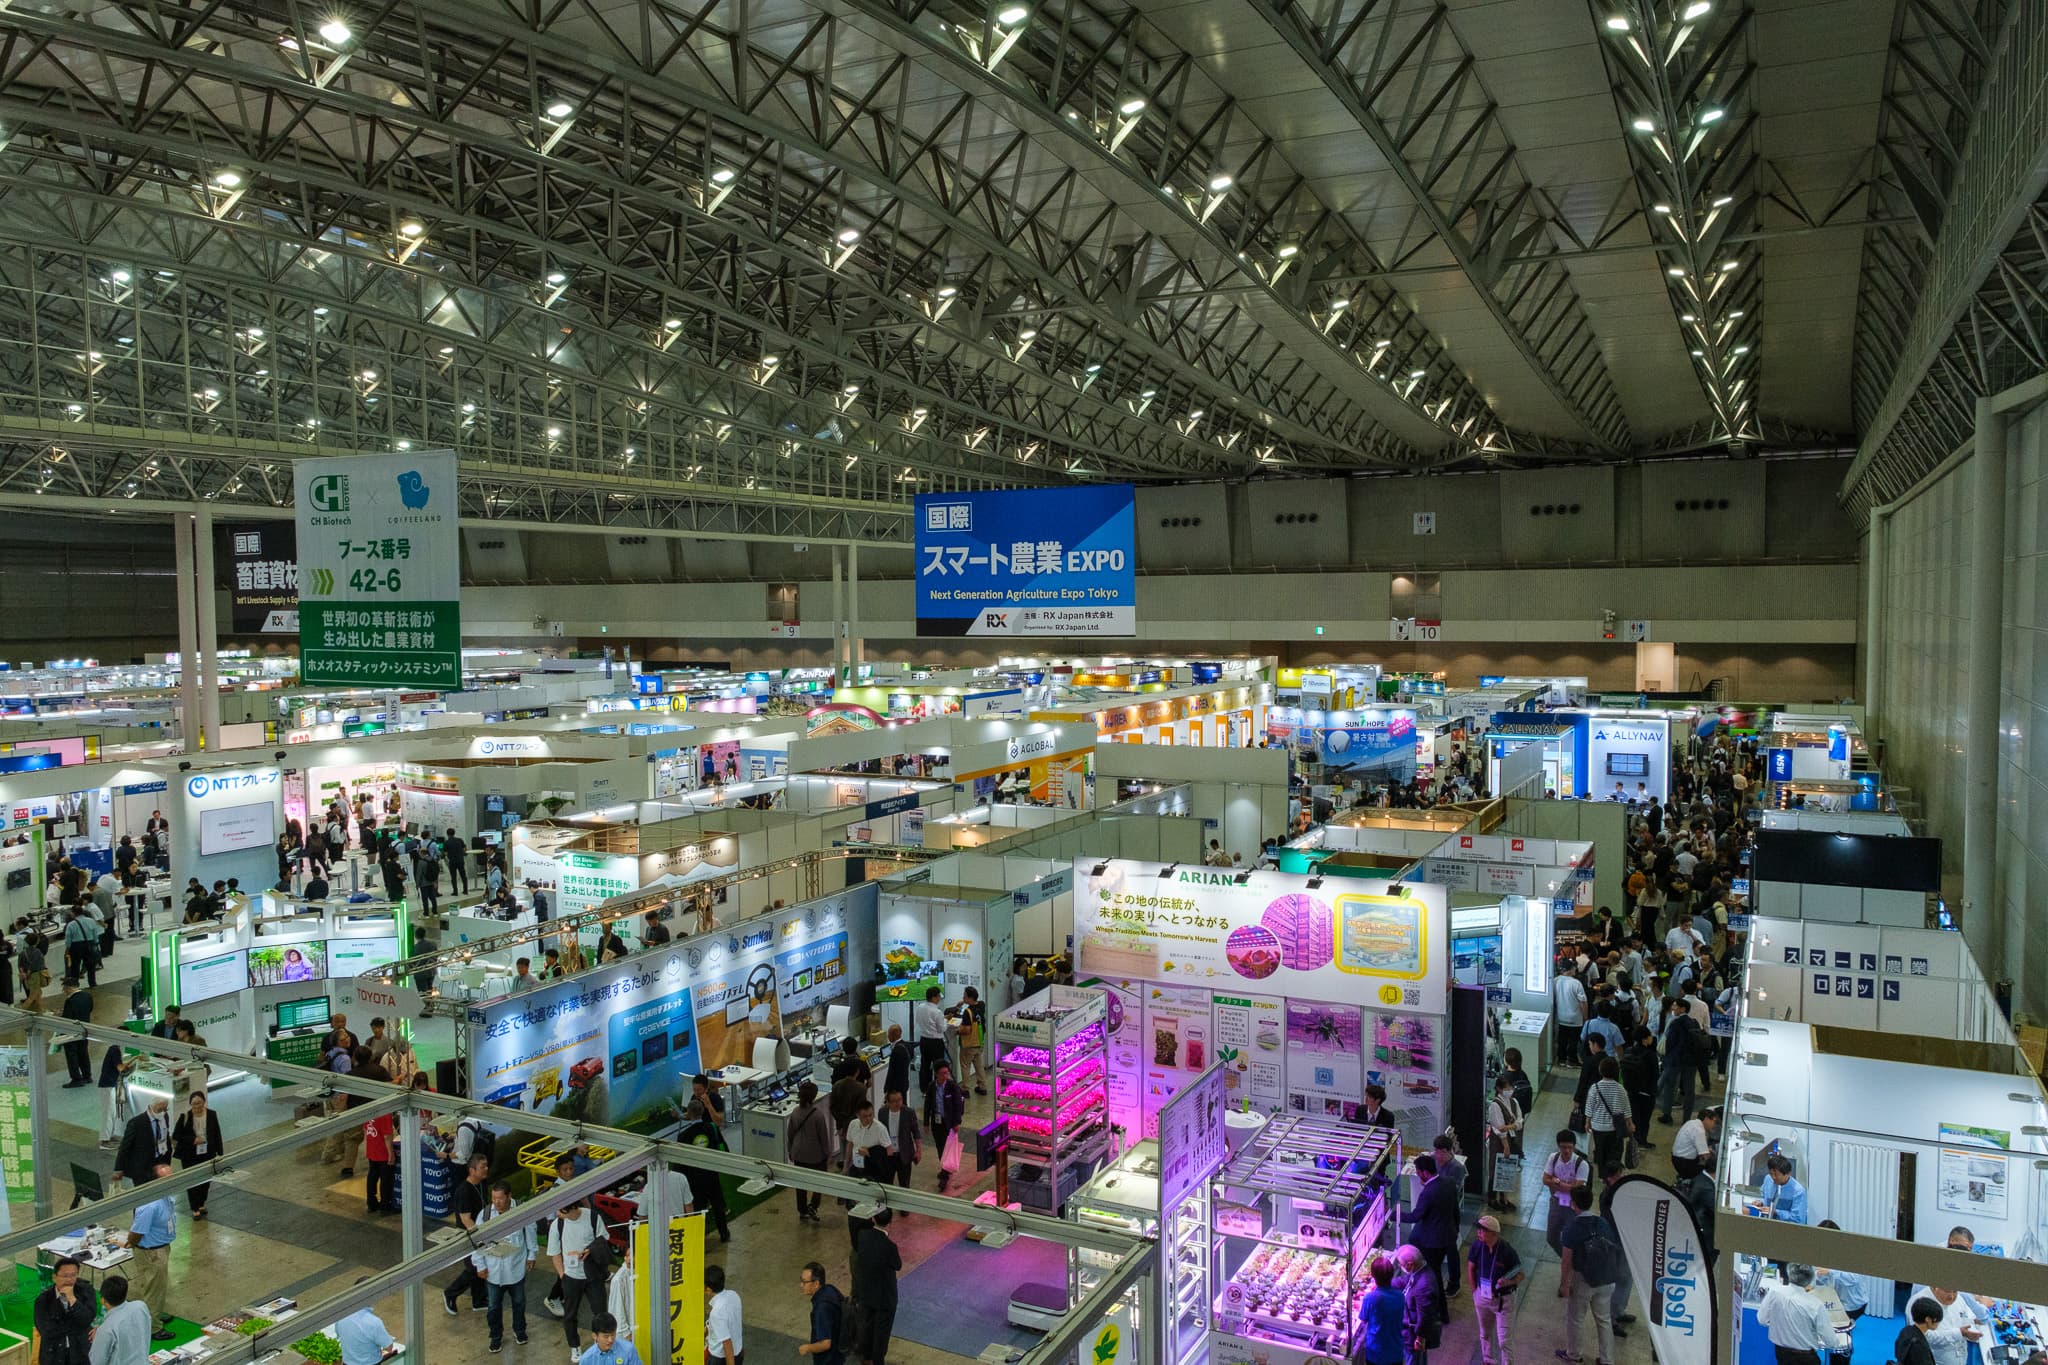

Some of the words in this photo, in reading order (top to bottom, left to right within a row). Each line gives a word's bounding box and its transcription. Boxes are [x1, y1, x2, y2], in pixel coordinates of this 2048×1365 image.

[311, 517, 321, 526] CH
[323, 516, 351, 526] Biotech
[388, 515, 442, 524] COFFEELAND
[928, 505, 970, 529] 国際
[235, 535, 260, 553] 国際
[338, 538, 411, 561] ブース番号
[349, 567, 401, 593] 42-6
[247, 596, 268, 604] Livestock
[270, 596, 286, 605] Supply
[931, 589, 951, 600] Next
[954, 588, 1003, 600] Generation
[1006, 588, 1058, 602] Agriculture
[1061, 588, 1085, 602] Expo
[1088, 587, 1118, 601] Tokyo
[272, 615, 284, 627] RX
[322, 610, 435, 628] 世界初の革新技術が
[986, 613, 1007, 628] RX
[1043, 611, 1056, 619] RX
[788, 626, 795, 637] 9
[1066, 624, 1086, 632] Japan
[1420, 627, 1436, 640] 10
[323, 630, 435, 649] 生み出した農業資材
[1508, 724, 1558, 734] ALLYNAV
[1613, 730, 1663, 742] ALLYNAV
[1021, 740, 1053, 754] AGLOBAL
[1776, 754, 1785, 775] NSW
[1113, 892, 1201, 912] この地の伝統が、
[1099, 906, 1229, 930] 未来の実りへとつながる
[742, 928, 774, 949] SunNav
[1115, 927, 1140, 935] Tradition
[1141, 929, 1157, 938] Meets
[1160, 932, 1193, 941] Tomorrow's
[1195, 935, 1218, 944] Harvest
[1786, 950, 1928, 975] スマート農業
[1816, 979, 1896, 997] ロボット
[357, 987, 396, 1007] TOYOTA
[485, 969, 661, 1041] 安全で快適な作業を実現するために
[1221, 997, 1244, 1006] メリット
[197, 1019, 208, 1028] CH
[210, 1011, 237, 1026] Biotech
[138, 1077, 164, 1089] Biotech
